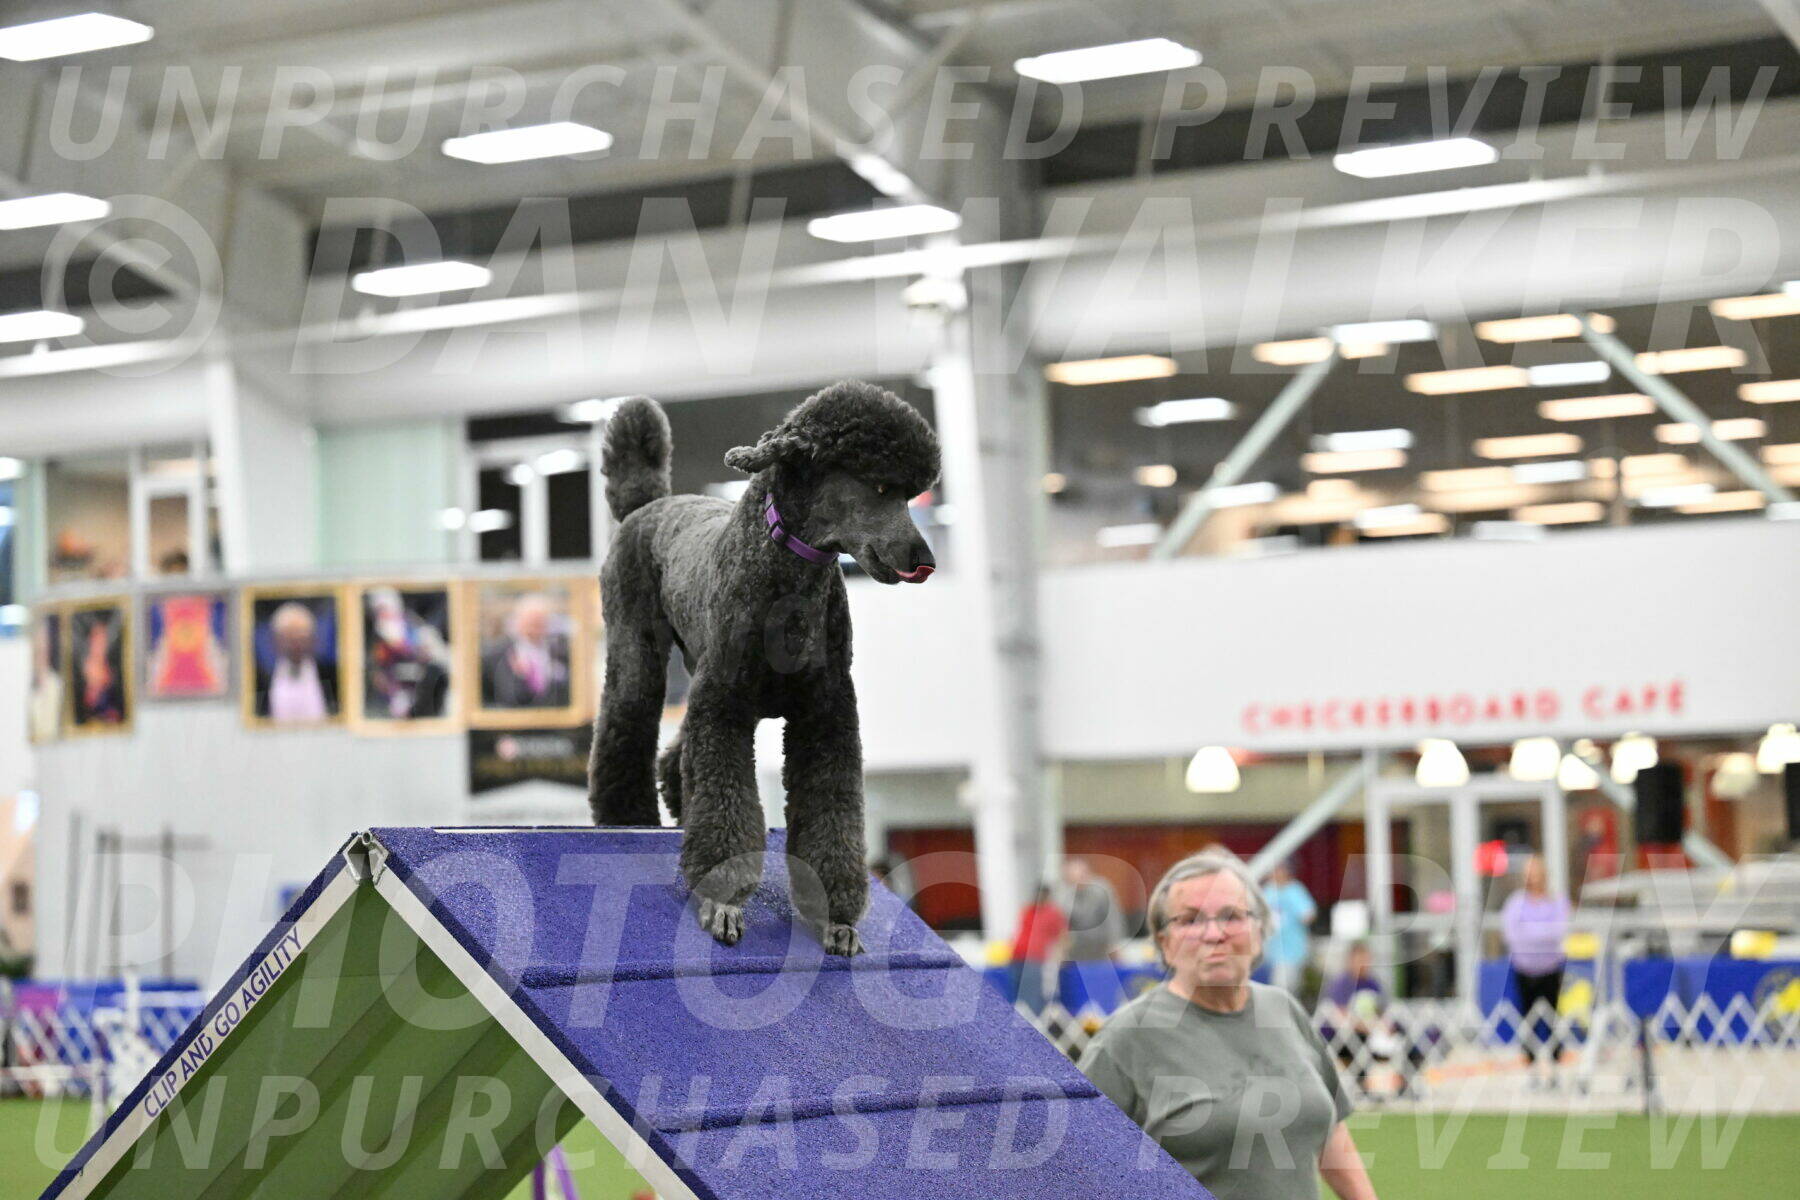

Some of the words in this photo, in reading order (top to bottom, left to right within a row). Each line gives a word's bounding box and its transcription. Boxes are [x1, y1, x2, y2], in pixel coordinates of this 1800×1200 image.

[144, 1071, 177, 1118] CLIP
[180, 1034, 213, 1080] AND
[214, 1002, 241, 1037] GO
[242, 926, 302, 1011] AGILITY
